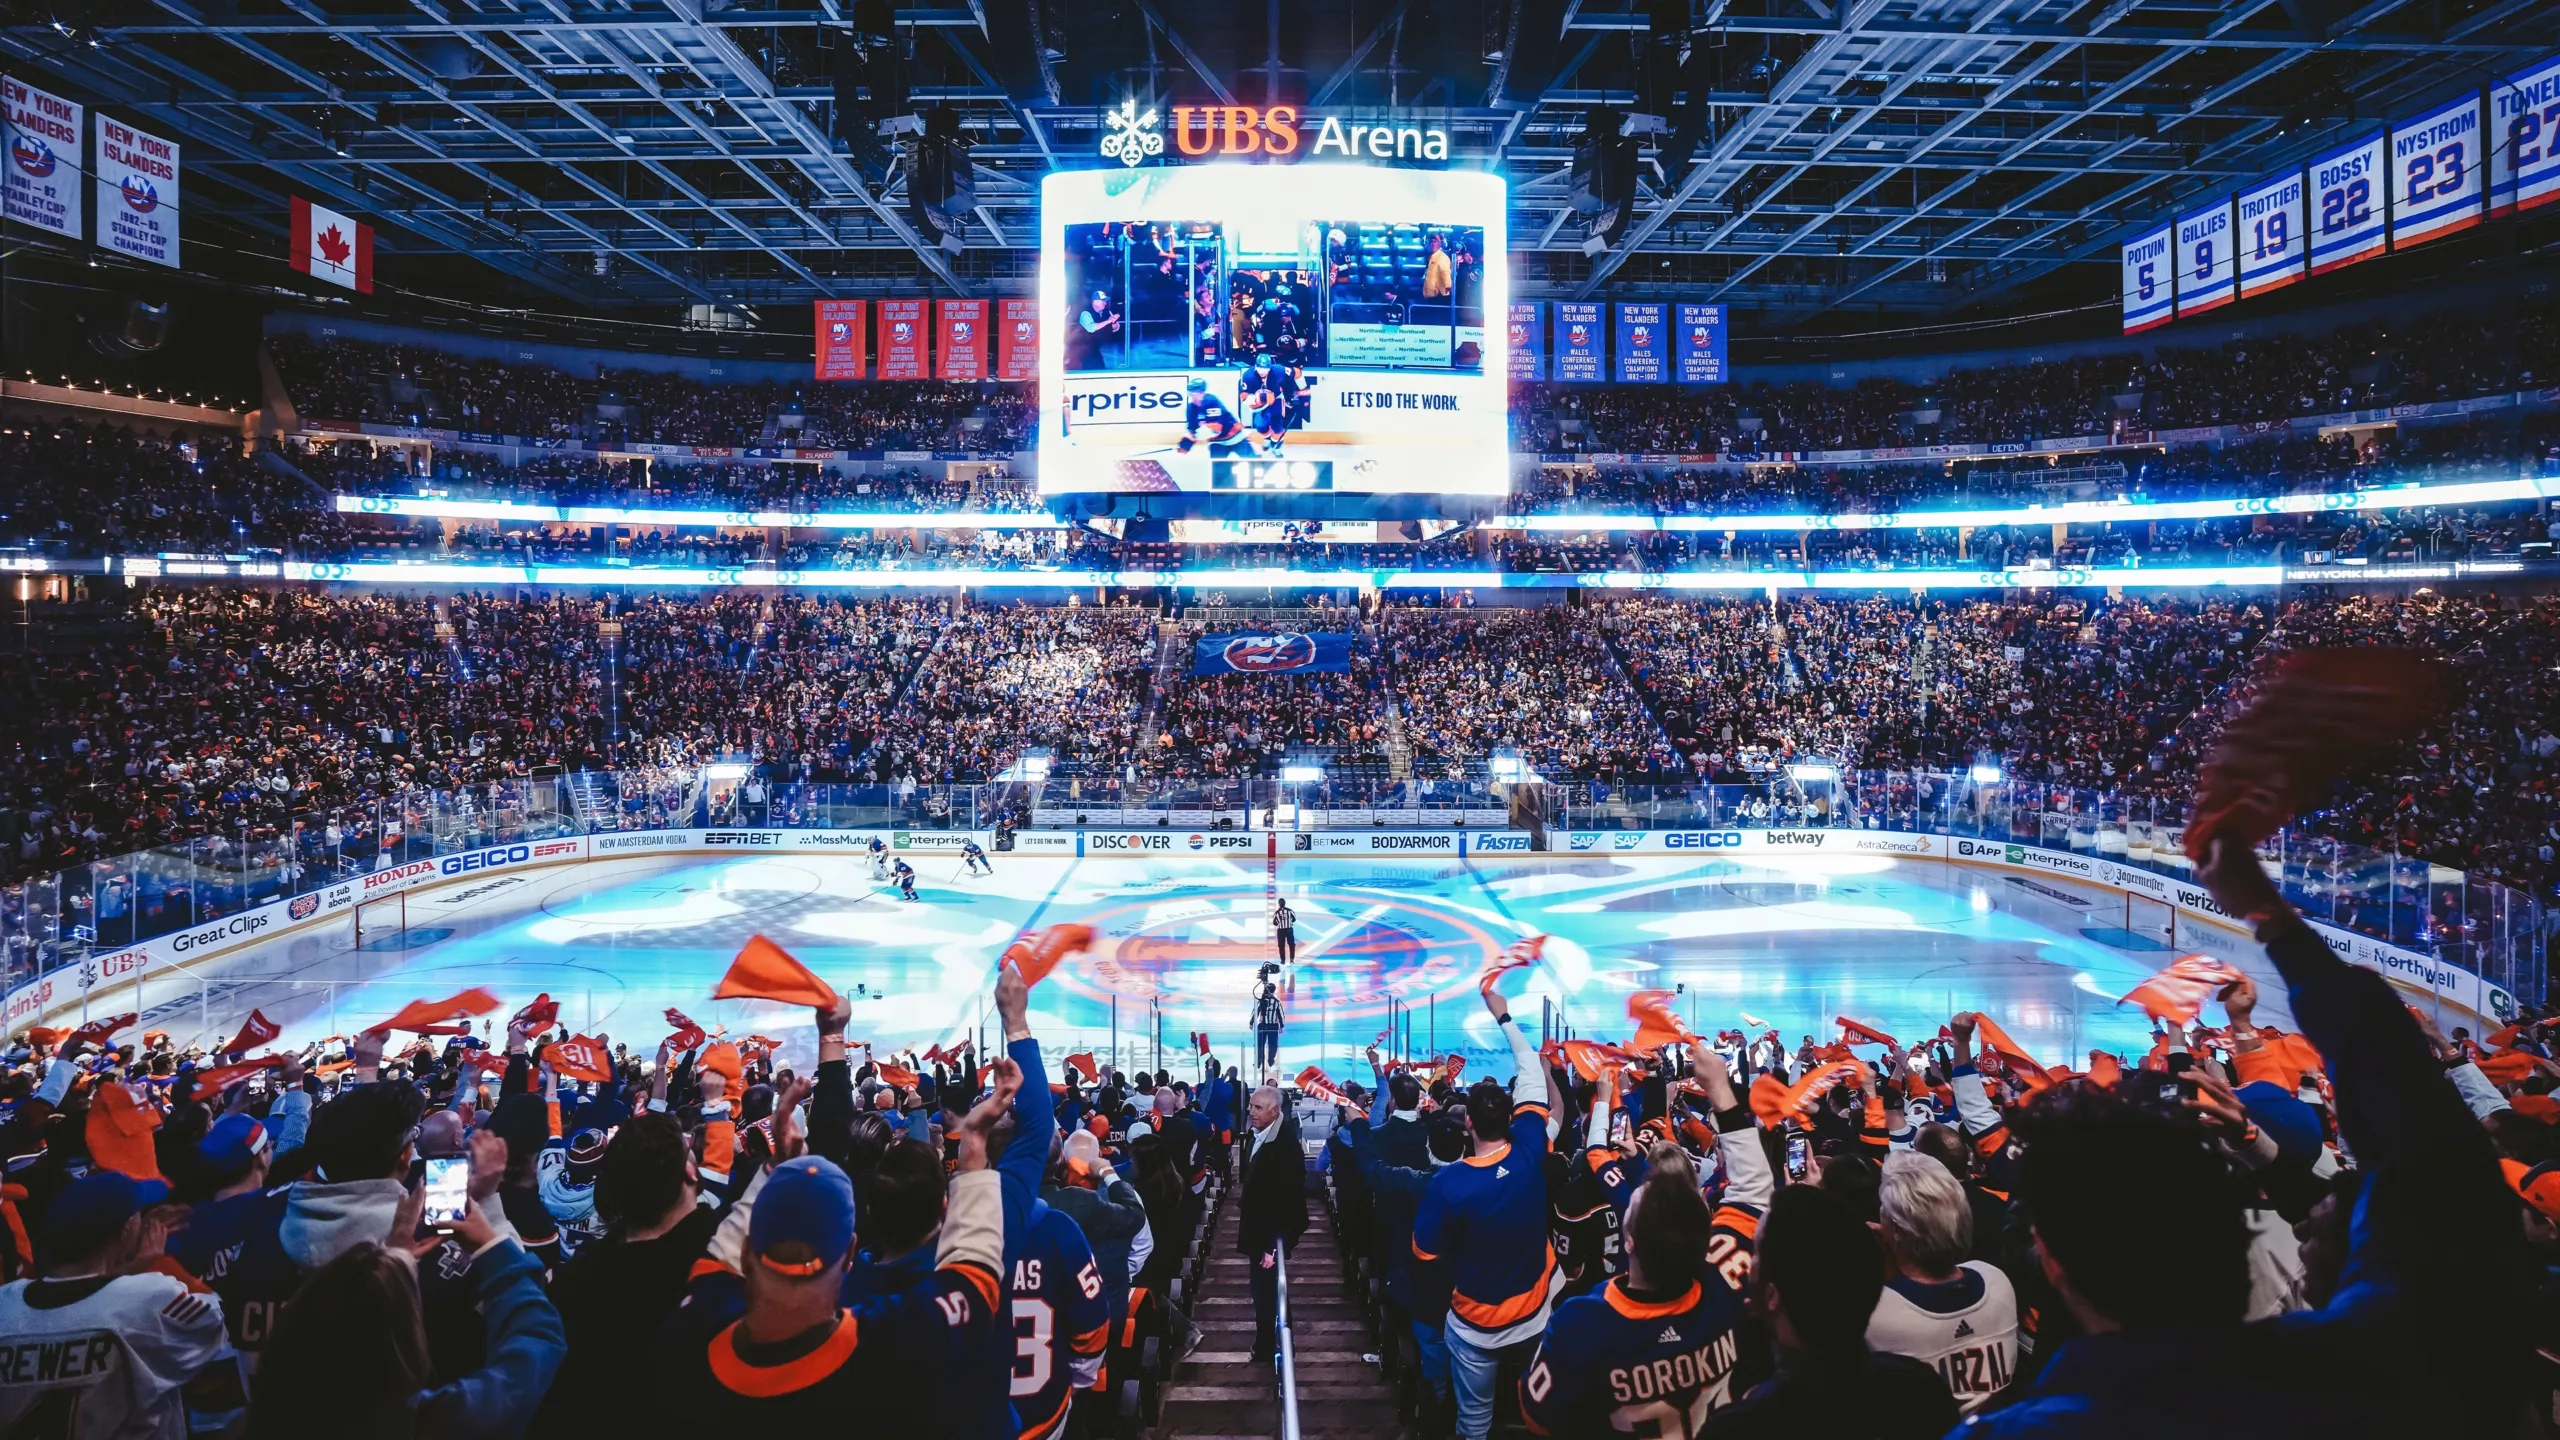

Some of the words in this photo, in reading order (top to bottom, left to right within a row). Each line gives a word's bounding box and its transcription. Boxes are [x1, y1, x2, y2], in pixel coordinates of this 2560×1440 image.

[34, 92, 73, 123] YORK
[104, 121, 134, 147] NEW
[139, 136, 171, 161] YORK
[1172, 105, 1299, 156] UBS
[1312, 116, 1449, 160] Arena
[2396, 110, 2476, 158] NYSTROM
[104, 141, 173, 181] ISLANDERS
[2320, 151, 2373, 190] BOSSY
[2407, 141, 2465, 206] 23
[49, 200, 66, 217] CUP
[2241, 183, 2300, 221] TROTTIER
[2321, 178, 2371, 236] 22
[3, 205, 65, 230] CHAMPIONS
[111, 221, 150, 242] STANLEY
[150, 232, 167, 246] CUP
[2182, 212, 2226, 244] GILLIES
[2253, 211, 2288, 261] 19
[114, 236, 165, 260] CHAMPIONS
[2127, 236, 2165, 266] POTVIN
[2195, 240, 2213, 280] 9
[2138, 262, 2155, 301] 5
[1562, 305, 1577, 313] NEW
[1579, 305, 1596, 313] YORK
[1562, 314, 1597, 322] ISLANDERS
[1624, 306, 1639, 314] NEW
[1684, 307, 1699, 315] NEW
[1684, 316, 1719, 324] ISLANDERS
[322, 328, 337, 336] 301
[519, 352, 533, 360] 302
[1561, 356, 1597, 364] CONFERENCE
[1684, 358, 1720, 366] CONFERENCE
[1625, 365, 1658, 373] CHAMPIONS
[1072, 385, 1184, 417] rprise
[1341, 391, 1373, 408] LET'S
[1376, 392, 1393, 409] DO
[1395, 393, 1419, 409] THE
[1421, 394, 1460, 411] WORK.
[1992, 444, 2025, 453] DEFEND
[1231, 462, 1317, 489] 1:49
[2287, 570, 2320, 580] NEW
[2322, 570, 2362, 579] YORK
[599, 838, 616, 849] NEW
[617, 836, 664, 848] AMSTERDAM
[665, 834, 687, 846] VODKA
[704, 832, 748, 845] ESPN
[749, 833, 783, 845] BET
[813, 834, 878, 845] MassMutu
[898, 836, 971, 846] enterprise
[1092, 835, 1171, 850] DISCOVER
[1209, 837, 1252, 847] PEPSI
[1312, 838, 1355, 846] BETMGM
[1371, 836, 1451, 849] BODYARMOR
[1571, 835, 1596, 848] SAP
[1614, 835, 1640, 848] SAP
[1664, 832, 1742, 848] GEICO
[1766, 831, 1825, 847] betway
[1856, 840, 1918, 852] AstraZeneca
[533, 842, 578, 858] ESPN
[441, 846, 530, 875] GEICO
[2007, 849, 2090, 871] enterprise
[364, 861, 436, 890] HONDA
[329, 890, 334, 898] a
[336, 886, 350, 897] sub
[377, 884, 398, 895] Power
[398, 880, 407, 889] of
[328, 895, 352, 909] above
[173, 926, 226, 952] Great
[229, 913, 269, 937] Clips
[2321, 934, 2351, 954] tual
[101, 948, 148, 977] UBS
[2374, 948, 2456, 990] Northwell
[1013, 1260, 1042, 1291] AS
[1009, 1298, 1054, 1398] 3
[1610, 1328, 1738, 1401] SOROKIN
